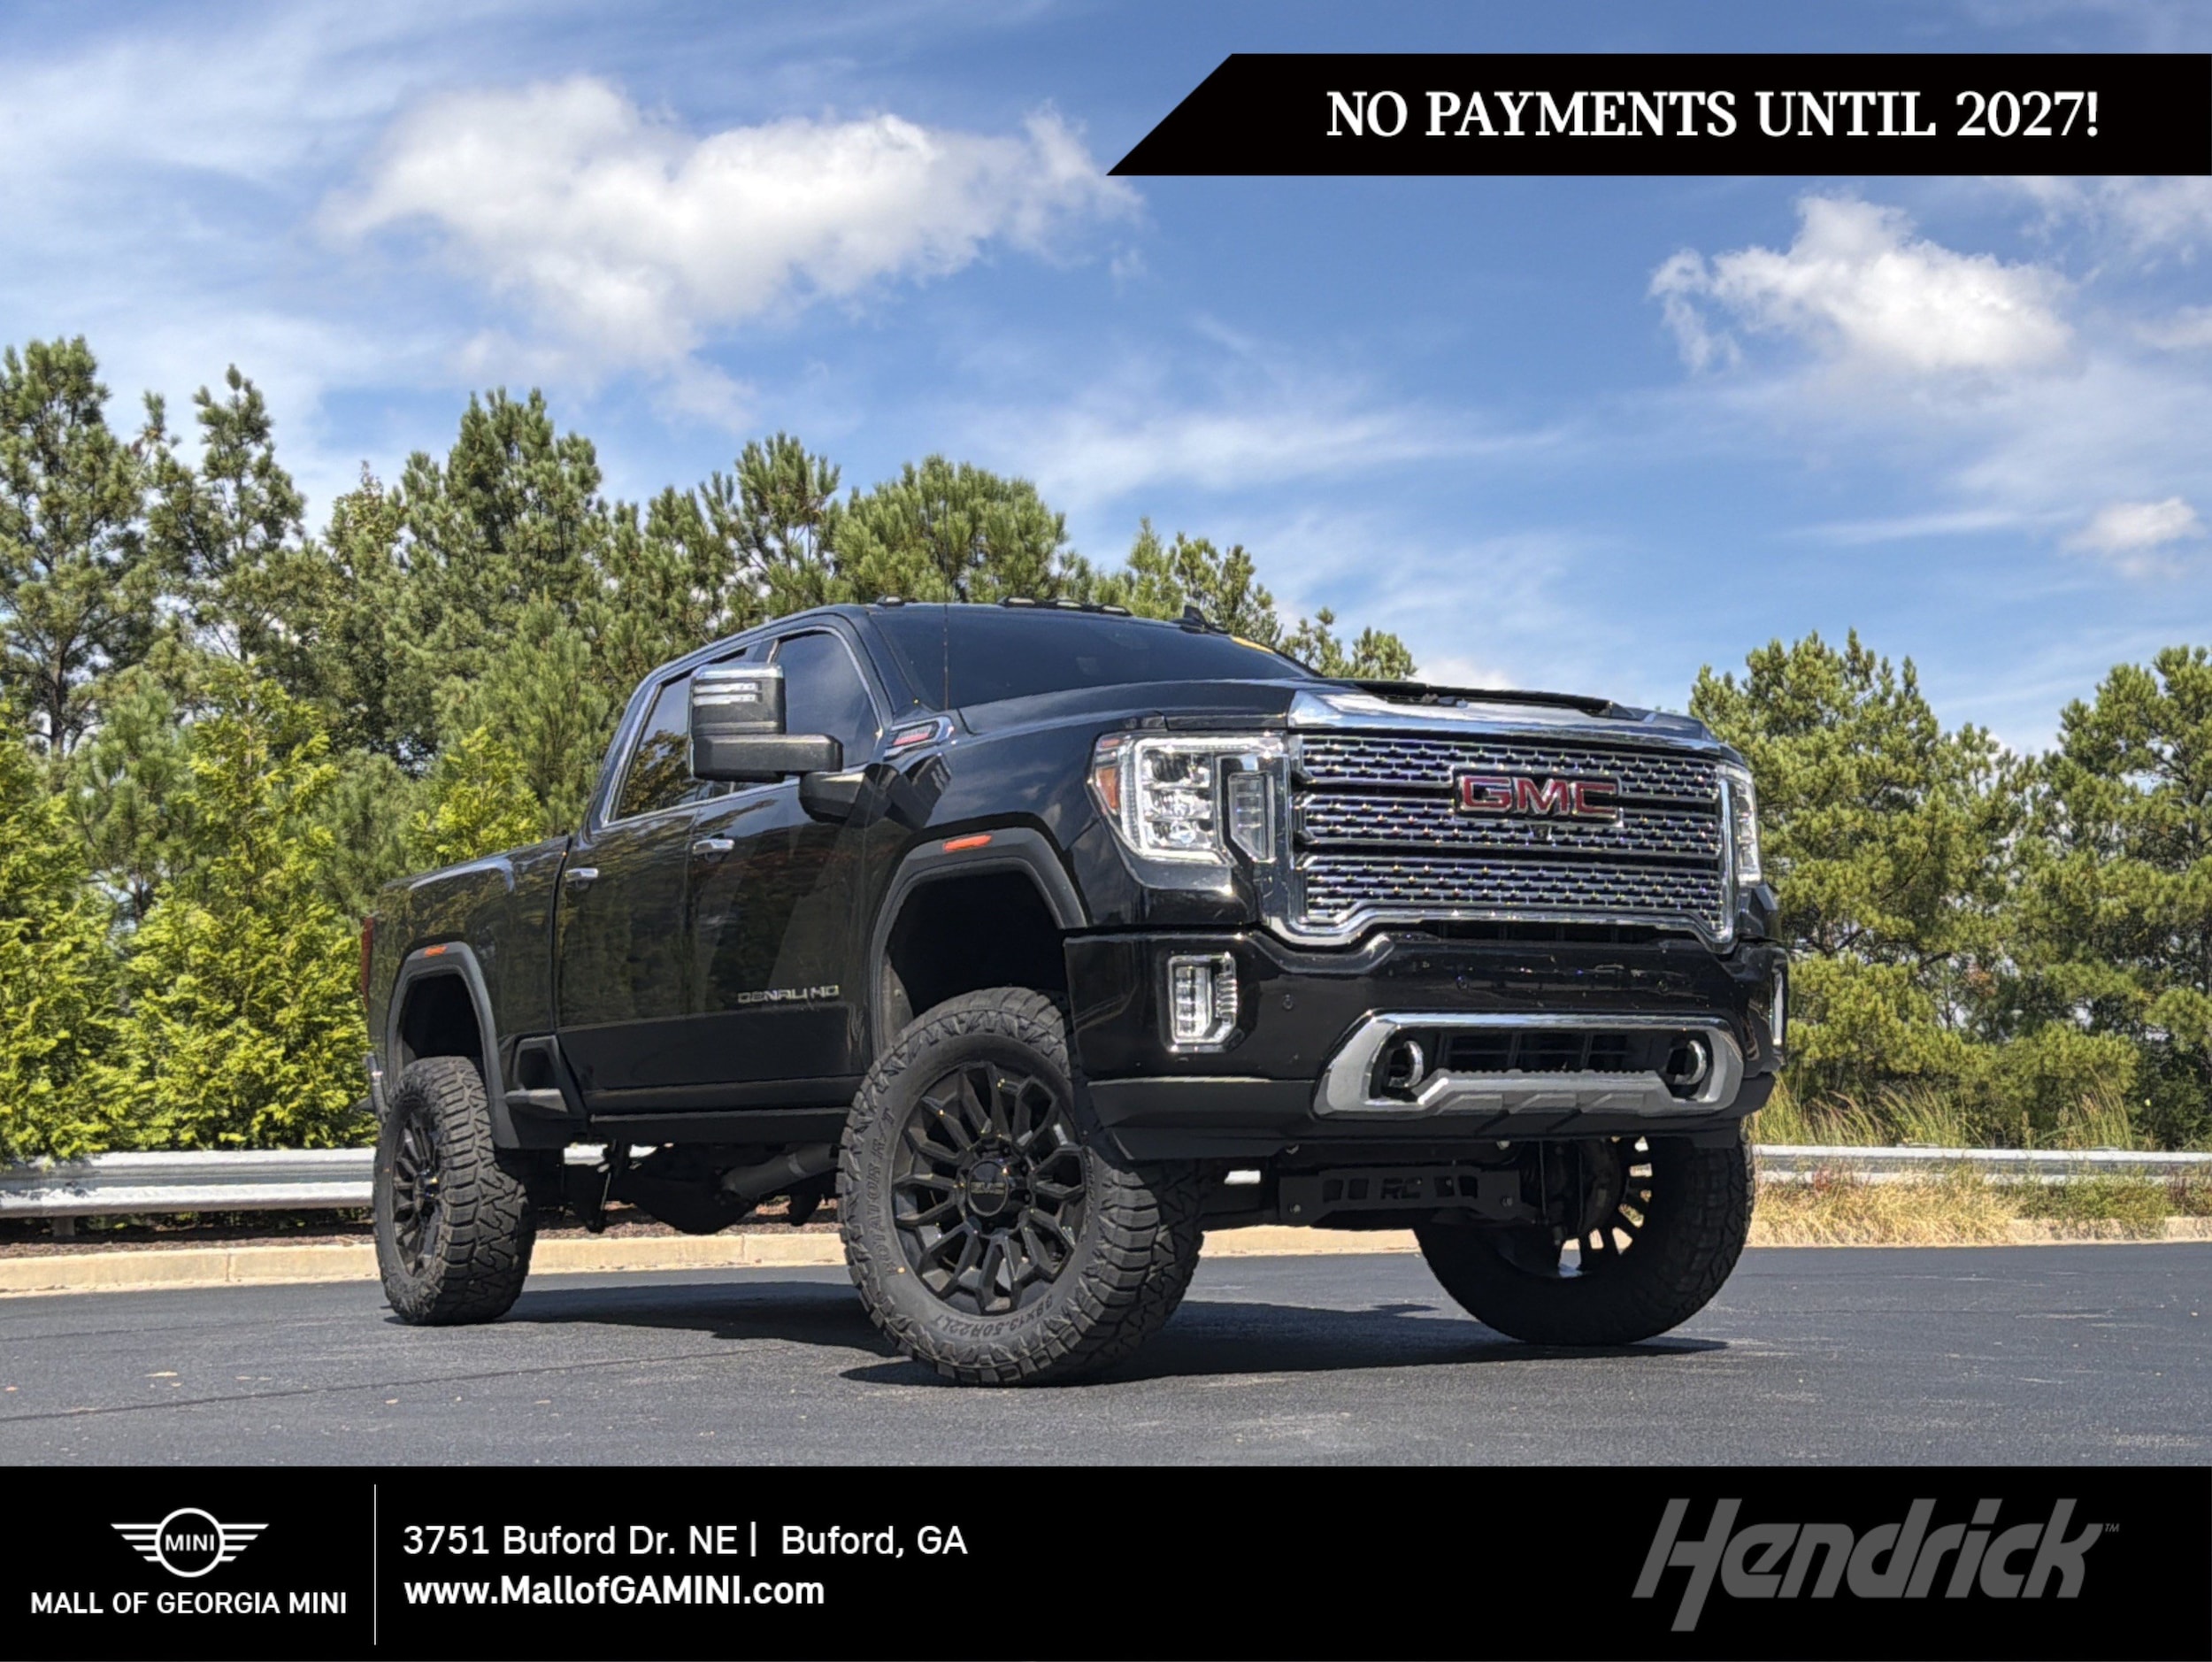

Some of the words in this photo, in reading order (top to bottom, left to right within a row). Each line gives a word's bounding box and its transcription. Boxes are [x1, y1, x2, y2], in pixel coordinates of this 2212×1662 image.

[1458, 775, 1617, 819] GMC
[738, 988, 807, 1004] DENALI
[810, 985, 840, 999] HD
